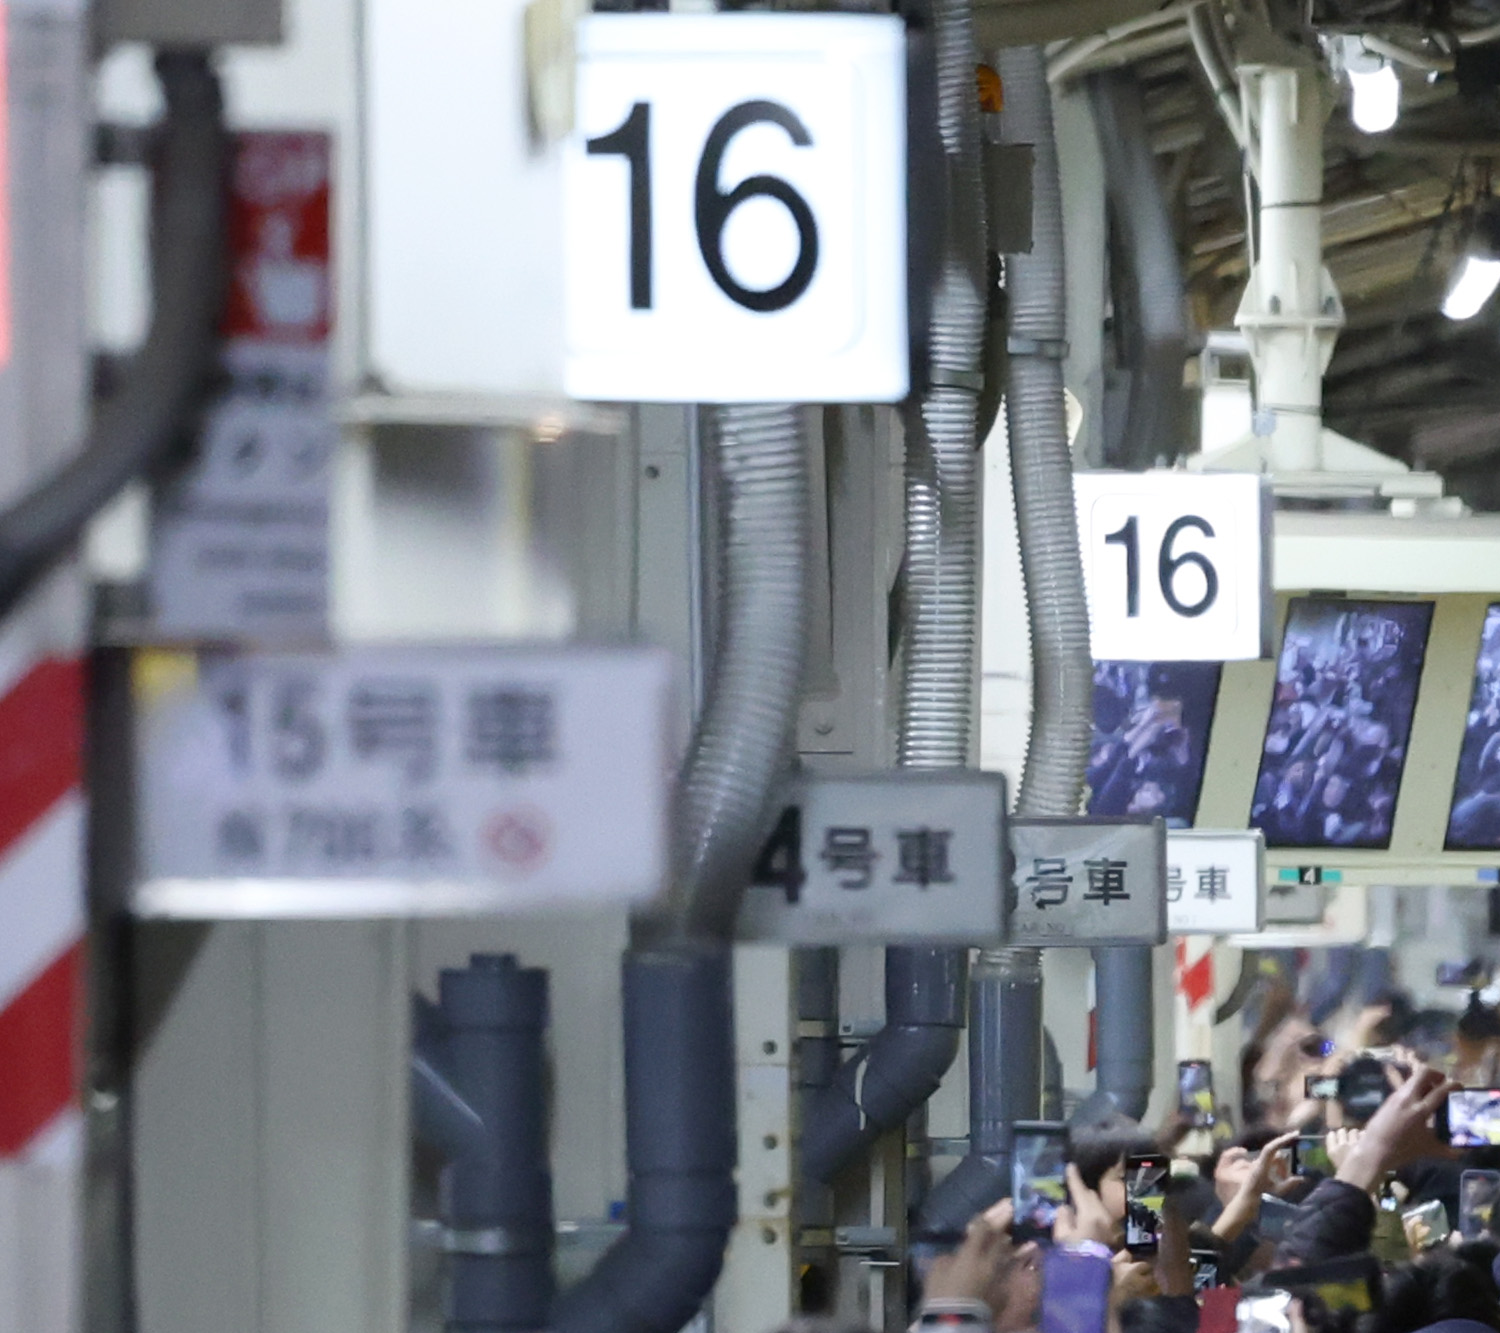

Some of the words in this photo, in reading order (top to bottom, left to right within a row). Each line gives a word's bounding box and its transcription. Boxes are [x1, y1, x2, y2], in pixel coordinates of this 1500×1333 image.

[586, 100, 819, 313] 16
[1103, 515, 1220, 618] 16
[208, 672, 566, 785] 15号車
